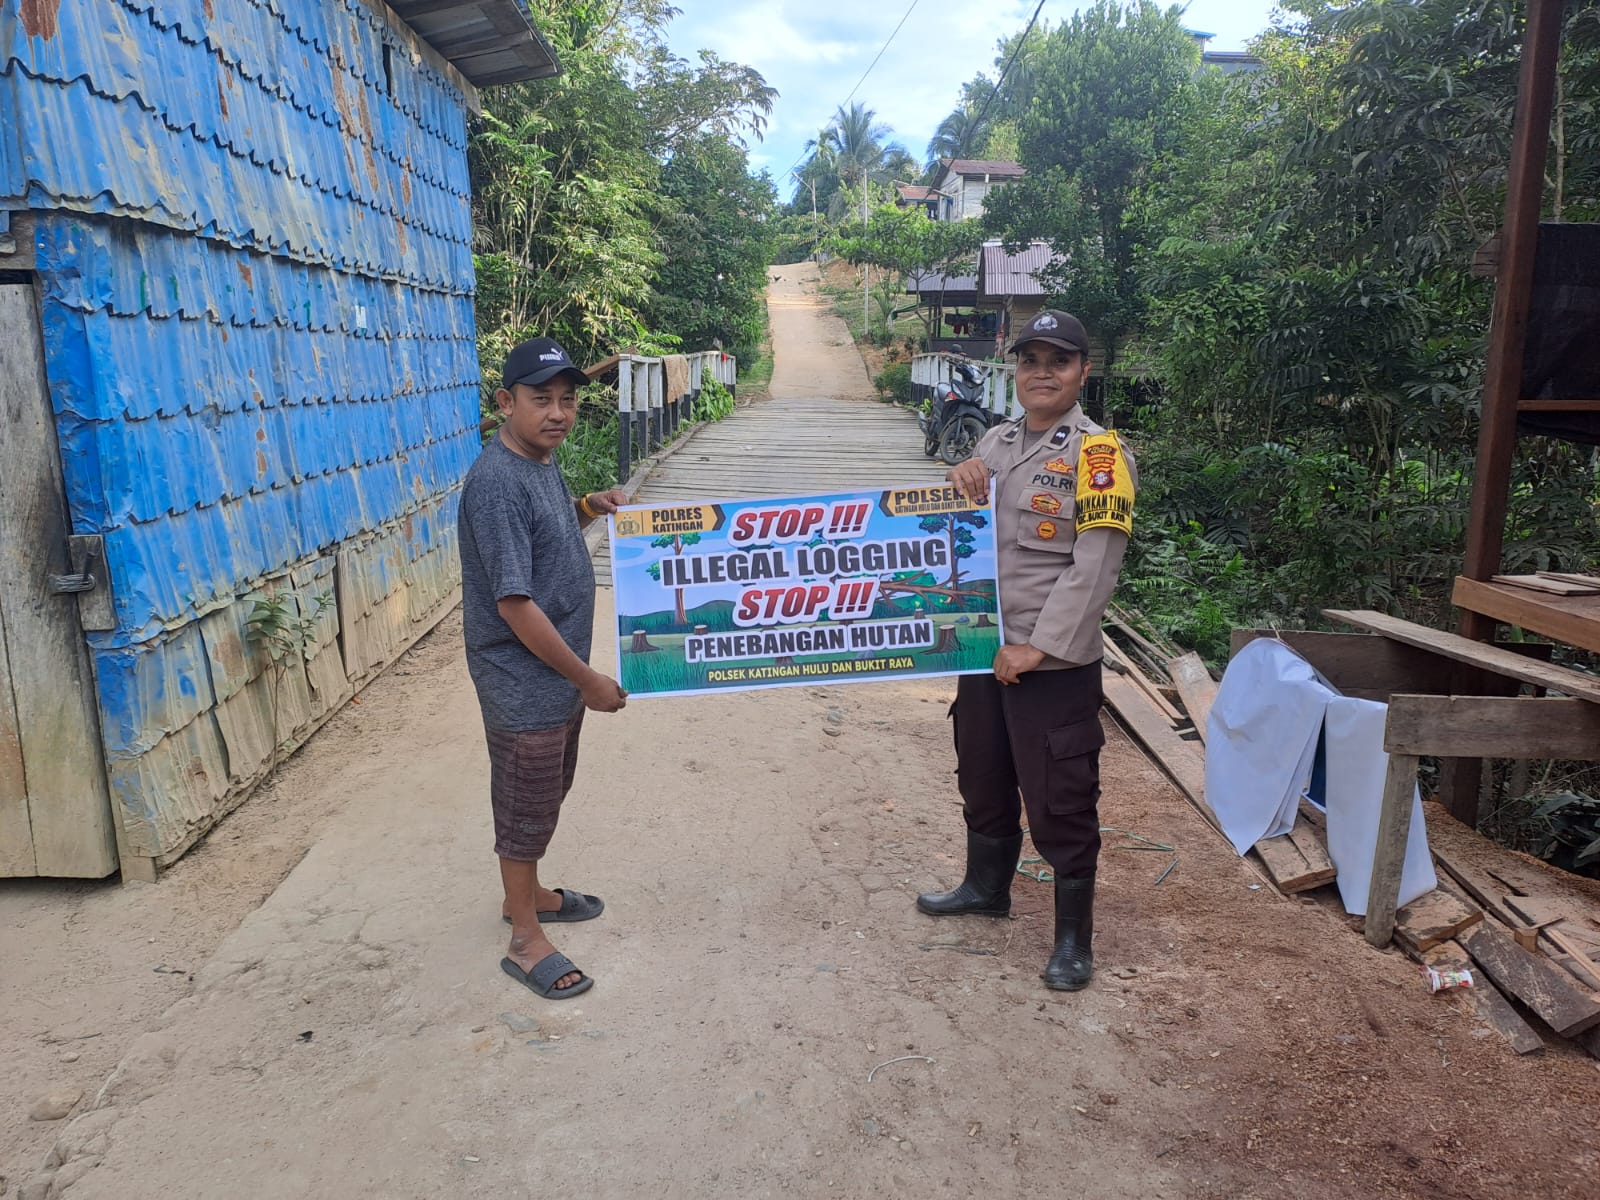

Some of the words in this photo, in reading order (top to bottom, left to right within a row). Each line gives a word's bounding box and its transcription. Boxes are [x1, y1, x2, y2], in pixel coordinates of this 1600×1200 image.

[1032, 474, 1073, 490] POLRI
[652, 507, 702, 523] POLRES
[652, 522, 703, 534] KATINGAN
[733, 507, 824, 542] STOP
[828, 503, 869, 534] !!!
[662, 551, 789, 586] ILLEGAL
[797, 538, 947, 576] LOGGING
[738, 585, 830, 621] STOP
[834, 581, 874, 614] !!!
[688, 628, 845, 660] PENEBANGAN
[851, 622, 931, 649] HUTAN
[708, 668, 746, 681] POLSEK
[748, 666, 801, 679] KATINGAN
[803, 663, 829, 675] HULU
[832, 661, 852, 673] DAN
[855, 659, 886, 672] BUKIT
[889, 657, 914, 669] RAYA
